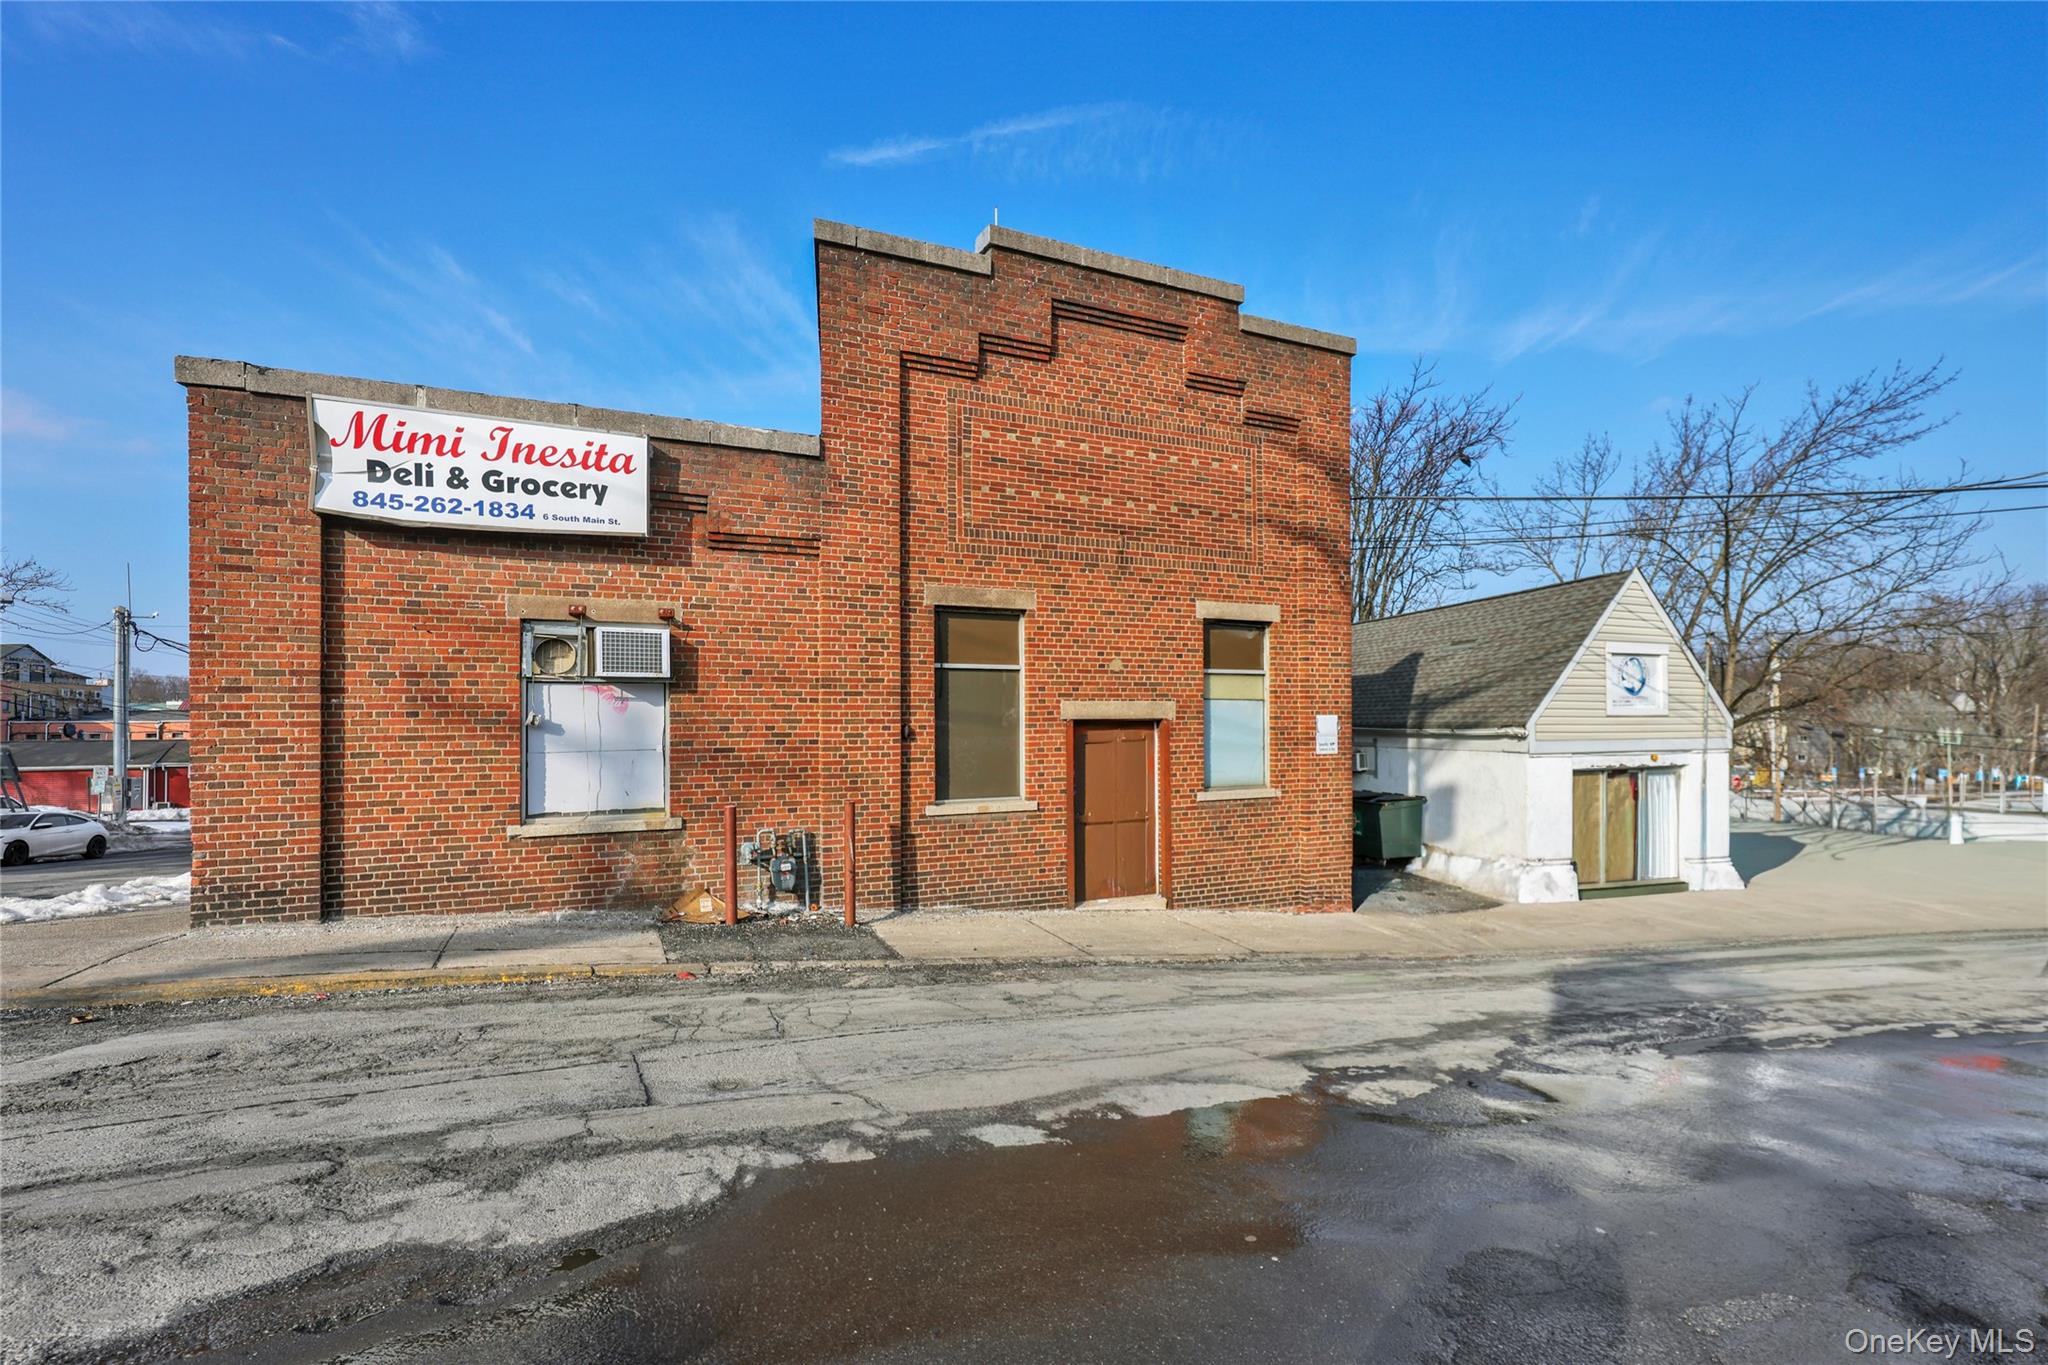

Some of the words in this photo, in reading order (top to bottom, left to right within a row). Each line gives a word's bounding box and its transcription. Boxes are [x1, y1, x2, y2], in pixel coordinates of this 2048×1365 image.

[330, 411, 466, 458] Mimi
[480, 426, 638, 475] Inesita
[366, 459, 434, 488] Deli
[446, 466, 469, 490] &
[481, 469, 609, 506] Grocery
[352, 490, 536, 521] 845-262-1834
[542, 513, 549, 521] 6
[551, 513, 580, 523] South
[582, 516, 605, 525] Main
[608, 518, 621, 526] St.
